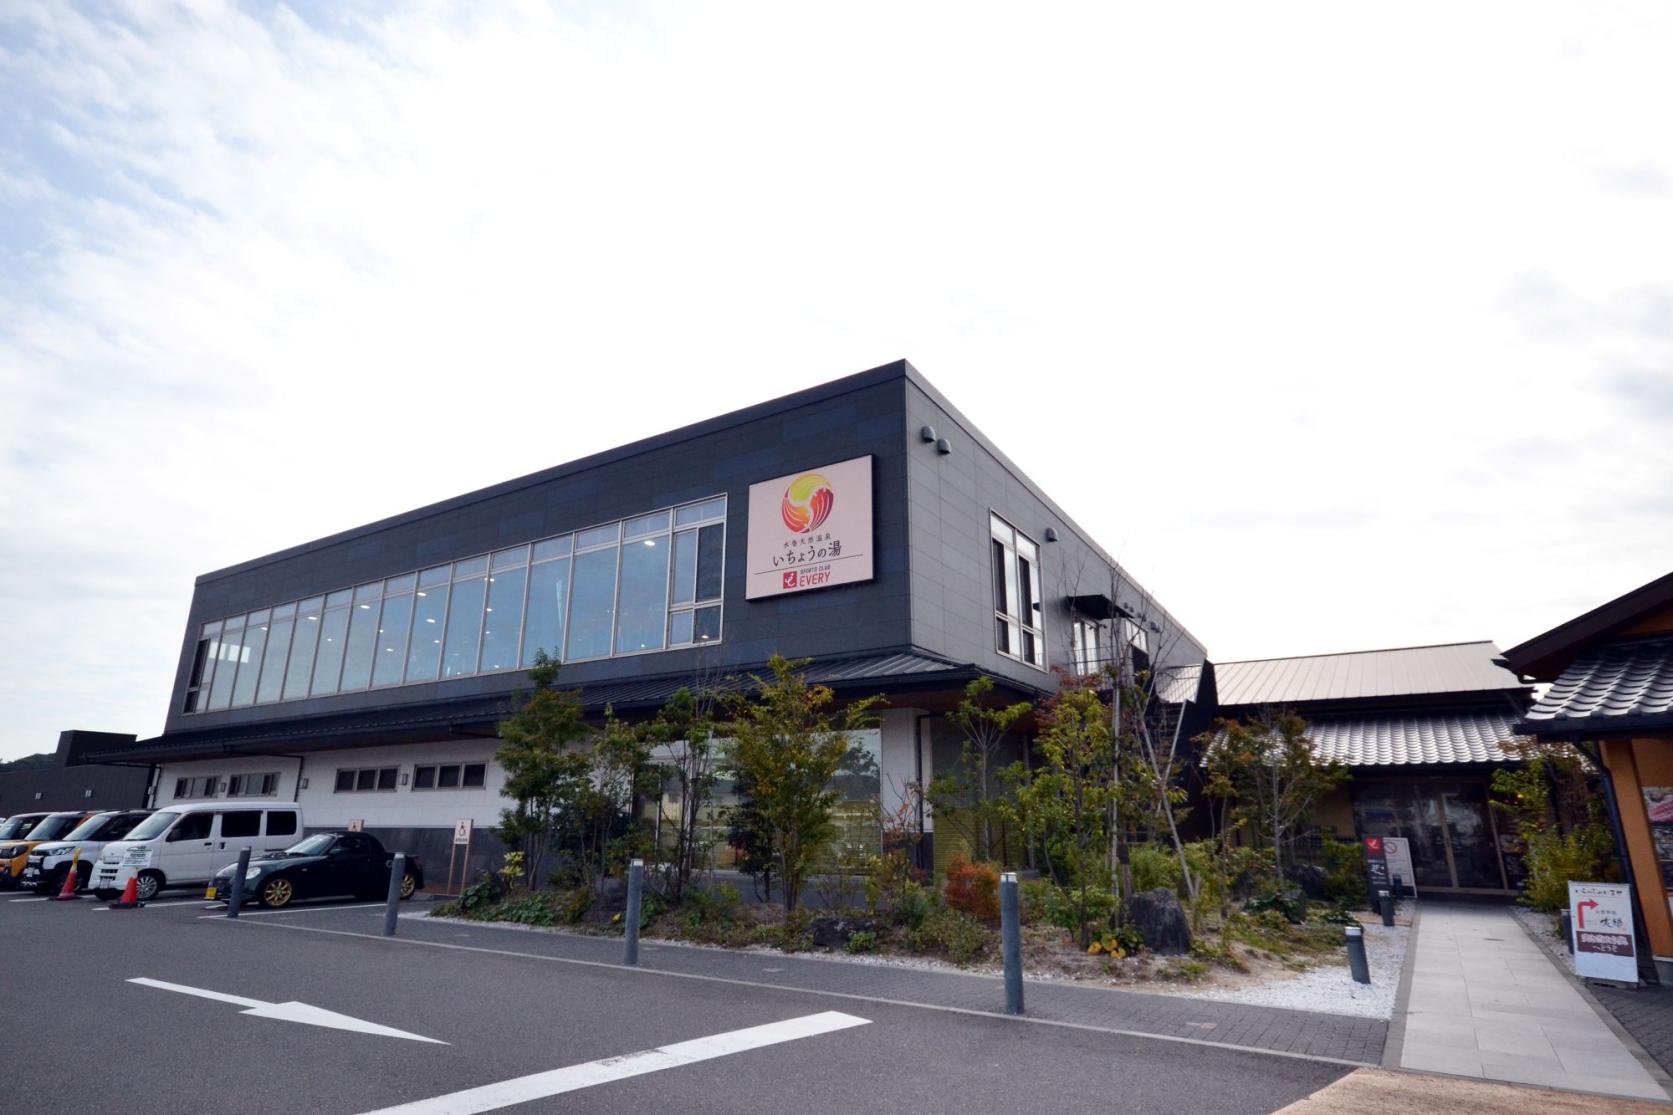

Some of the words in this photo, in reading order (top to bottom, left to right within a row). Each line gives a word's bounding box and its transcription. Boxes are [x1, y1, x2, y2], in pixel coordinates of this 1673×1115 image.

[773, 540, 841, 566] いちょうの湯
[799, 571, 831, 587] EVERY
